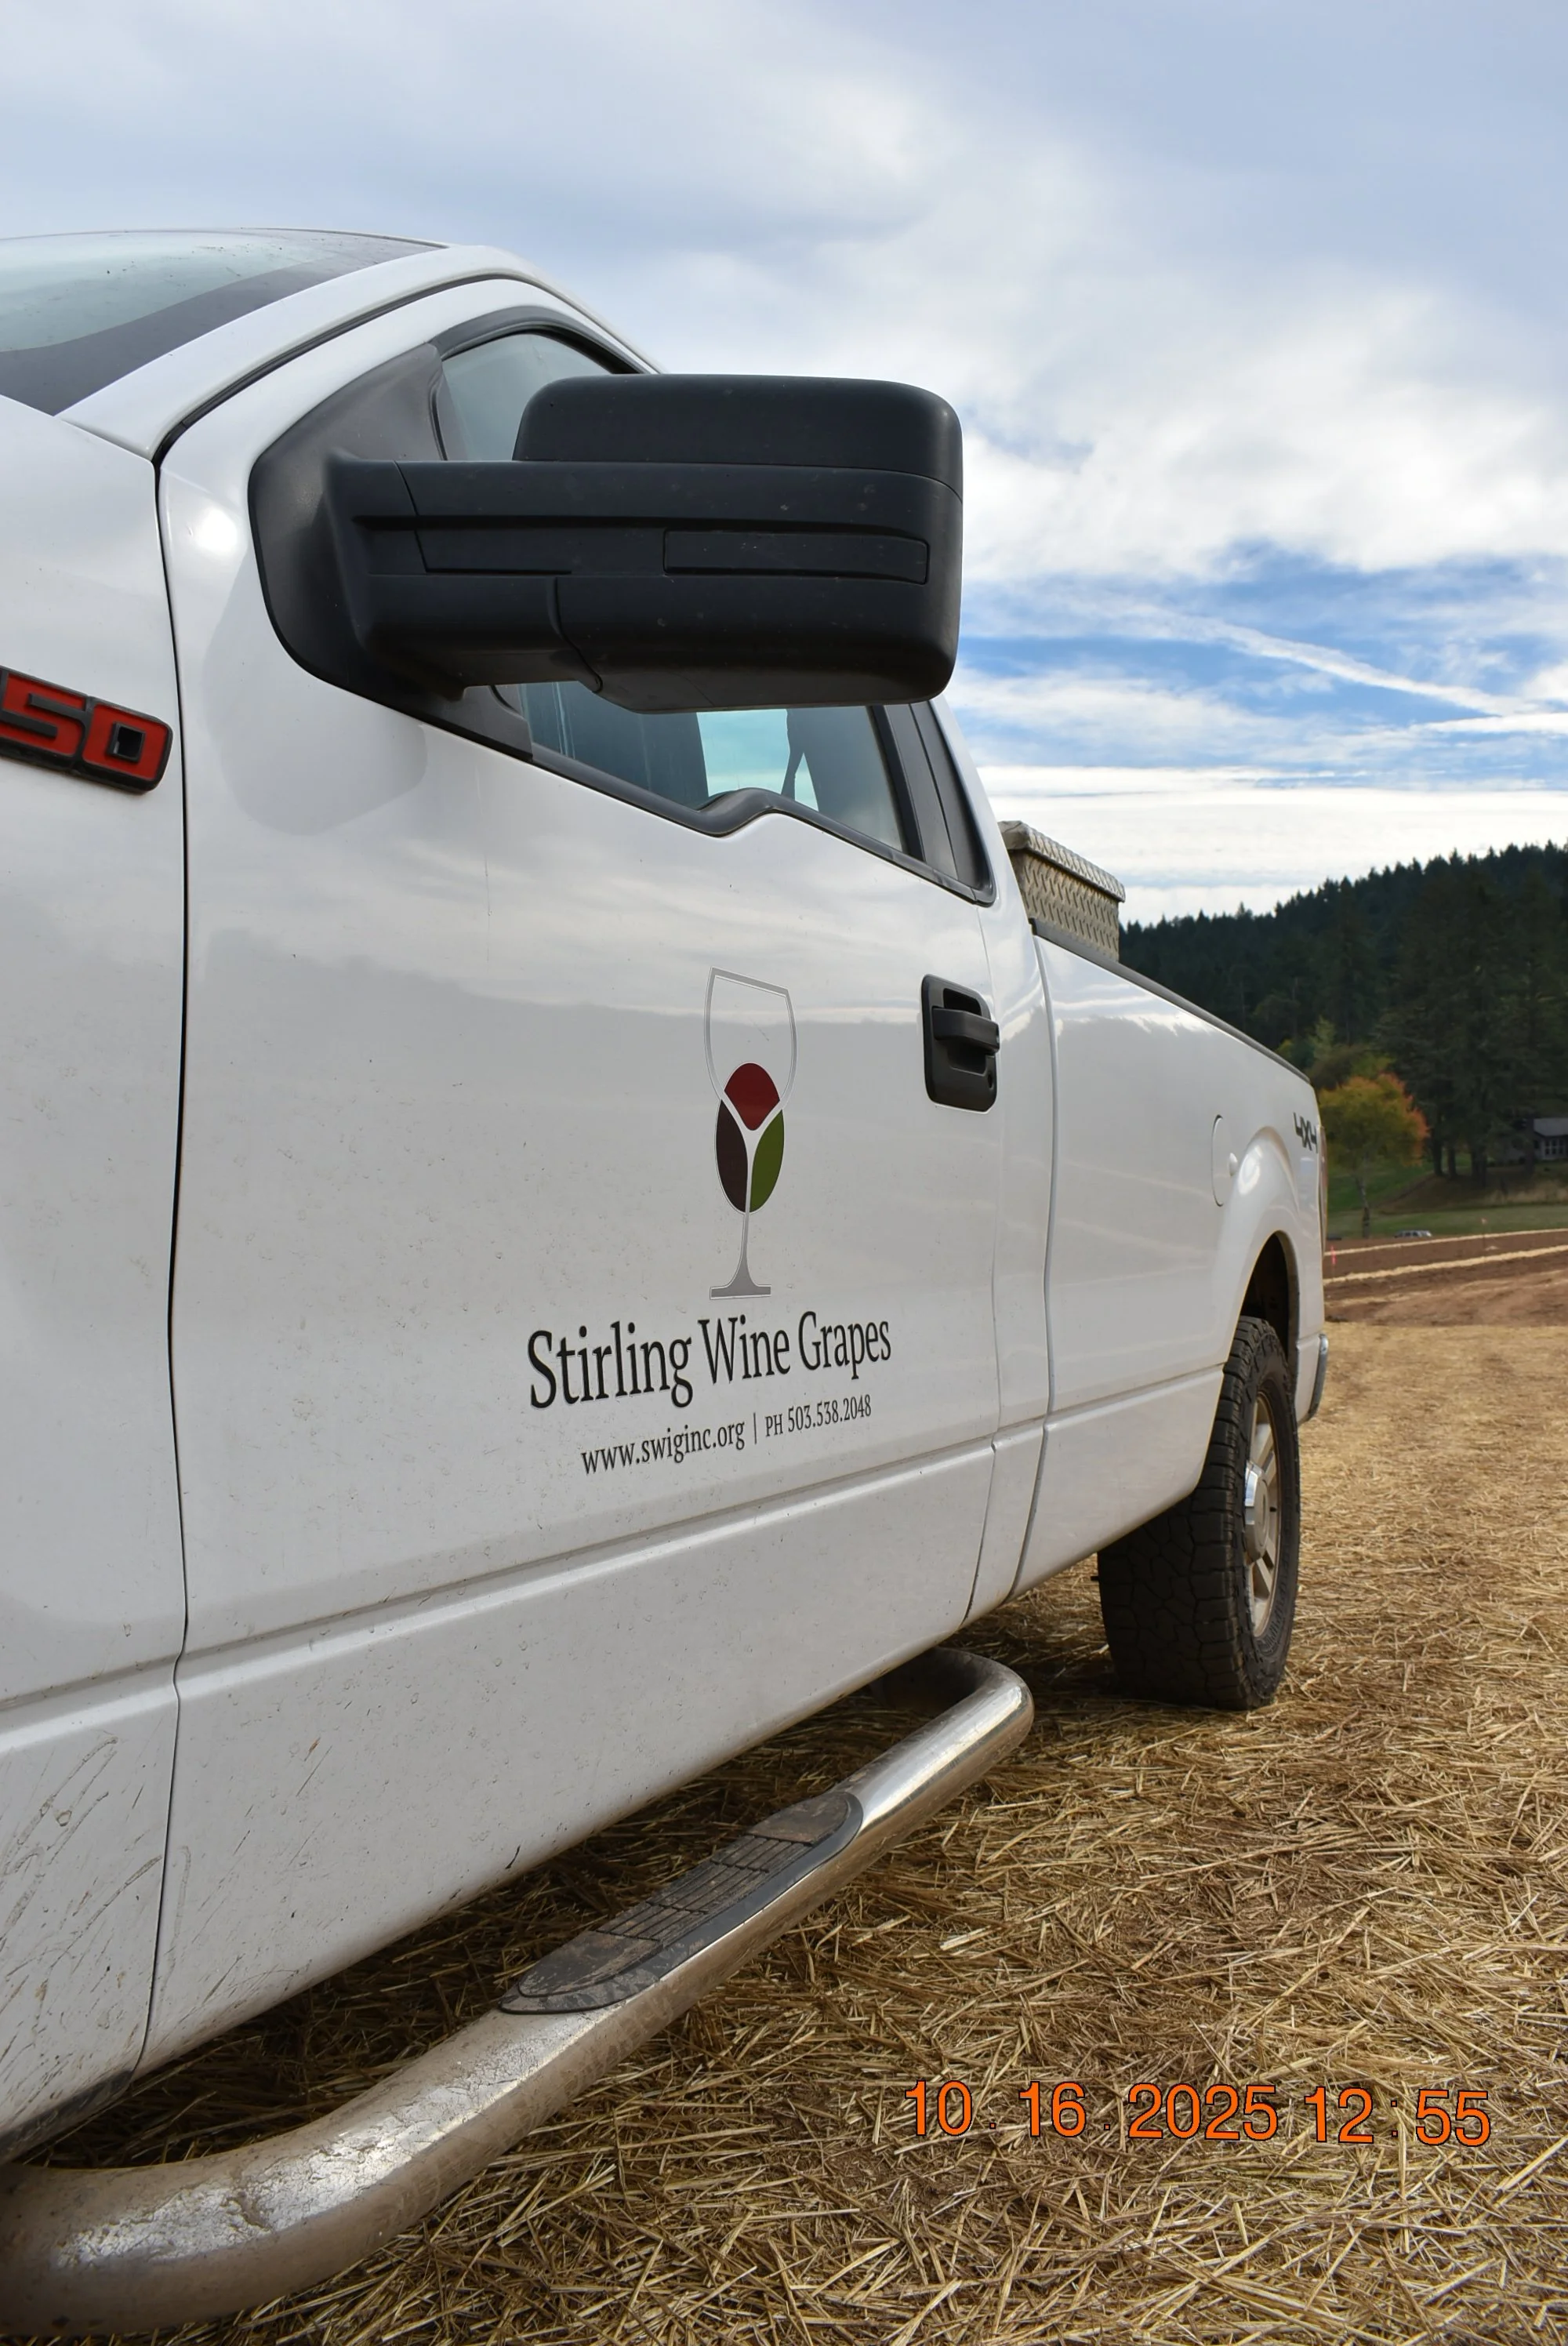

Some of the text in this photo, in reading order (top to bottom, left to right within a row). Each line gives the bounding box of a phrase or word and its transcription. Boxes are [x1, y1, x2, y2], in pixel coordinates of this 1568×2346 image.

[528, 1310, 891, 1408] Stirling Wine Grapes
[581, 1420, 746, 1475] www.swiginc.org
[765, 1413, 783, 1437] PH
[788, 1394, 872, 1433] 503.538.2048
